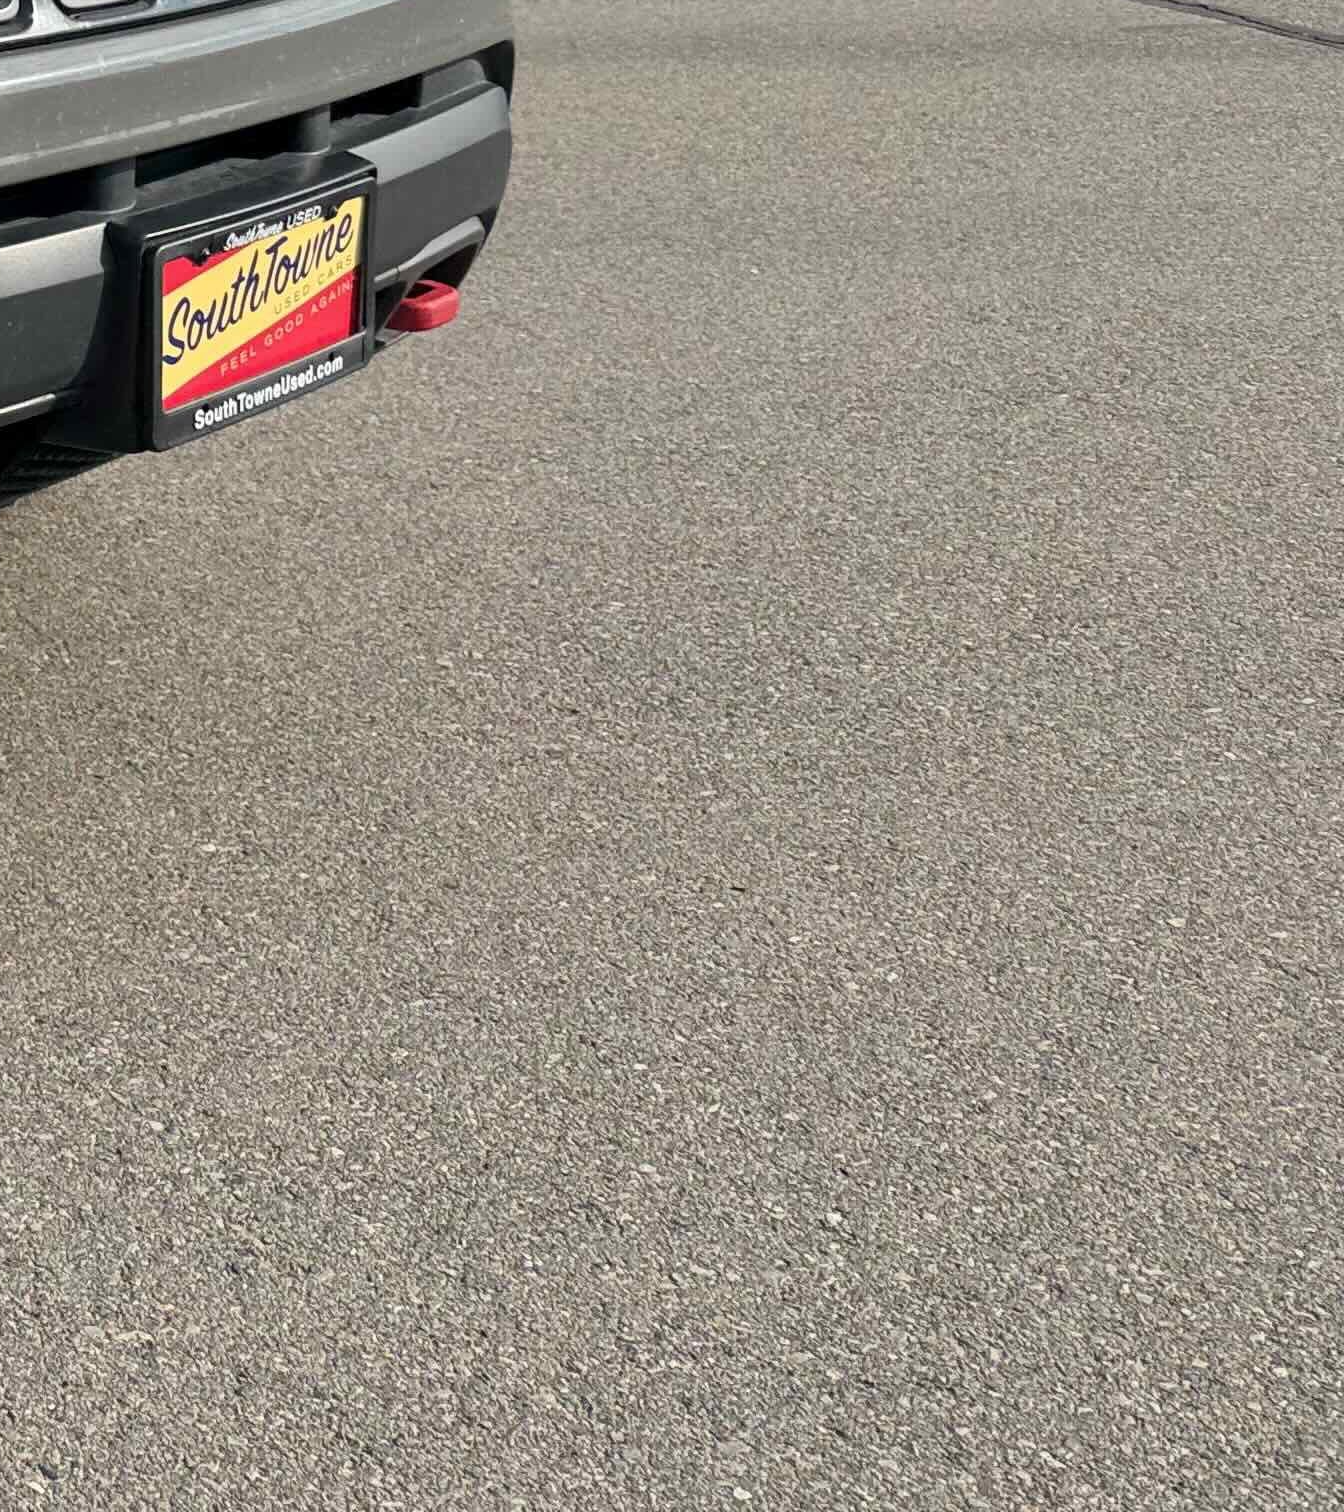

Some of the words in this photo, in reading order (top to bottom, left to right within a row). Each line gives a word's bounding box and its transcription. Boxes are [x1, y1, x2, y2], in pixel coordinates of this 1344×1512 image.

[287, 205, 322, 228] USED
[162, 213, 354, 365] SouthTowne
[274, 284, 310, 315] USED
[318, 254, 352, 286] CARS
[220, 345, 257, 377] FEEL
[264, 313, 304, 347] GOOD
[194, 354, 344, 431] SouthTowneUsed.com
